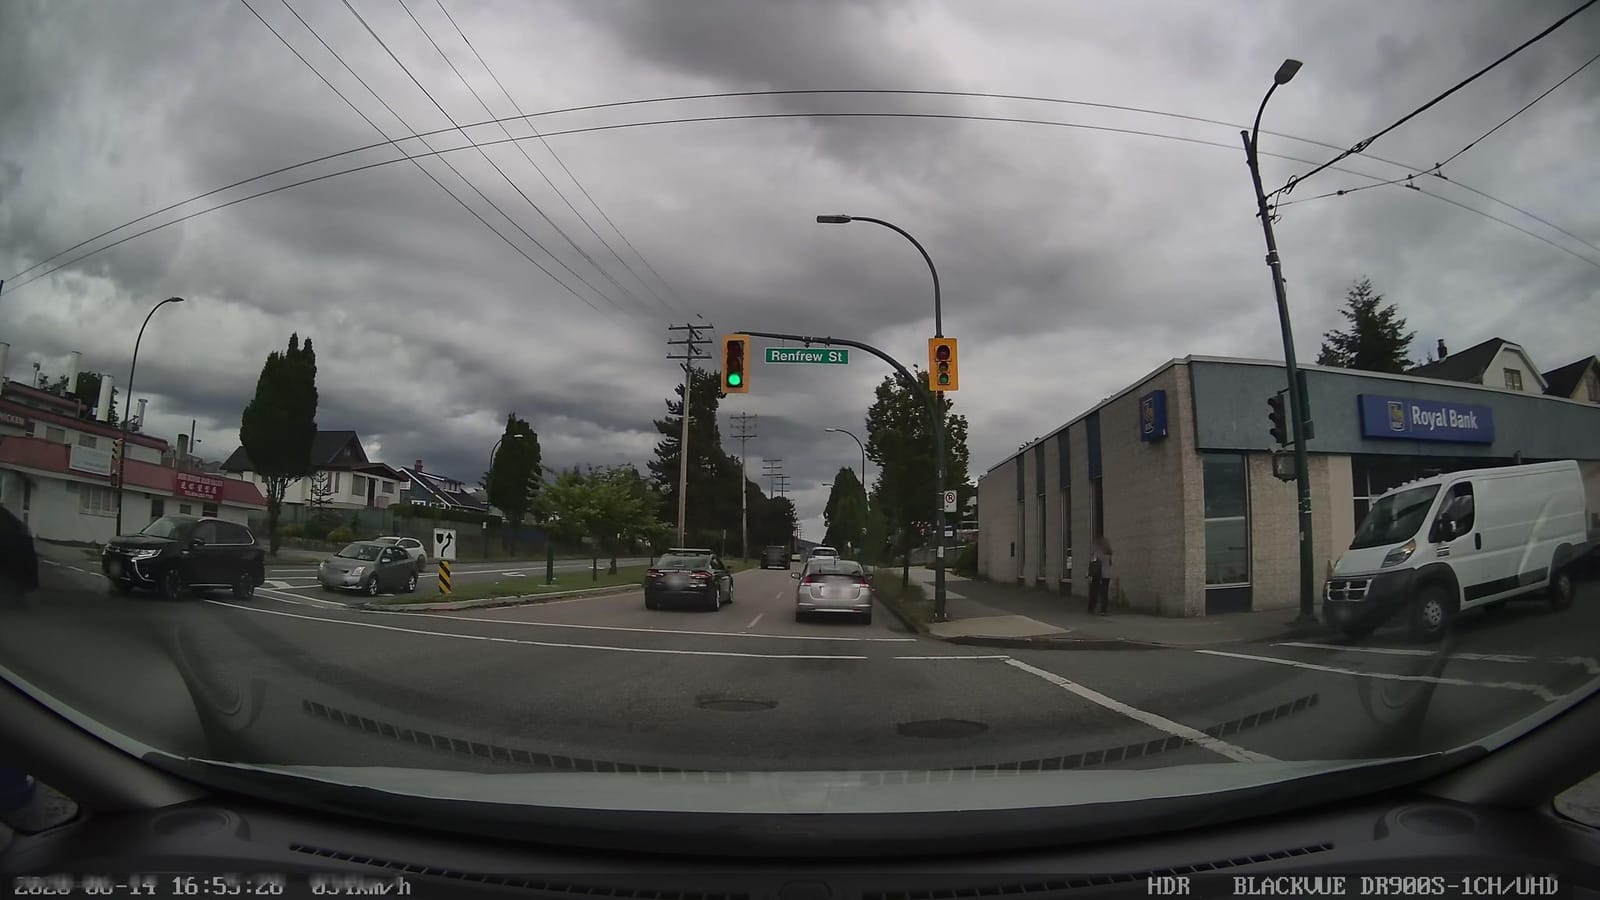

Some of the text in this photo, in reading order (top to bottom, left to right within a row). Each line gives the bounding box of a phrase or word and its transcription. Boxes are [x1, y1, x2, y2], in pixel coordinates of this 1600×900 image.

[771, 350, 843, 362] Renfrew St
[1411, 406, 1478, 431] Royal Bank
